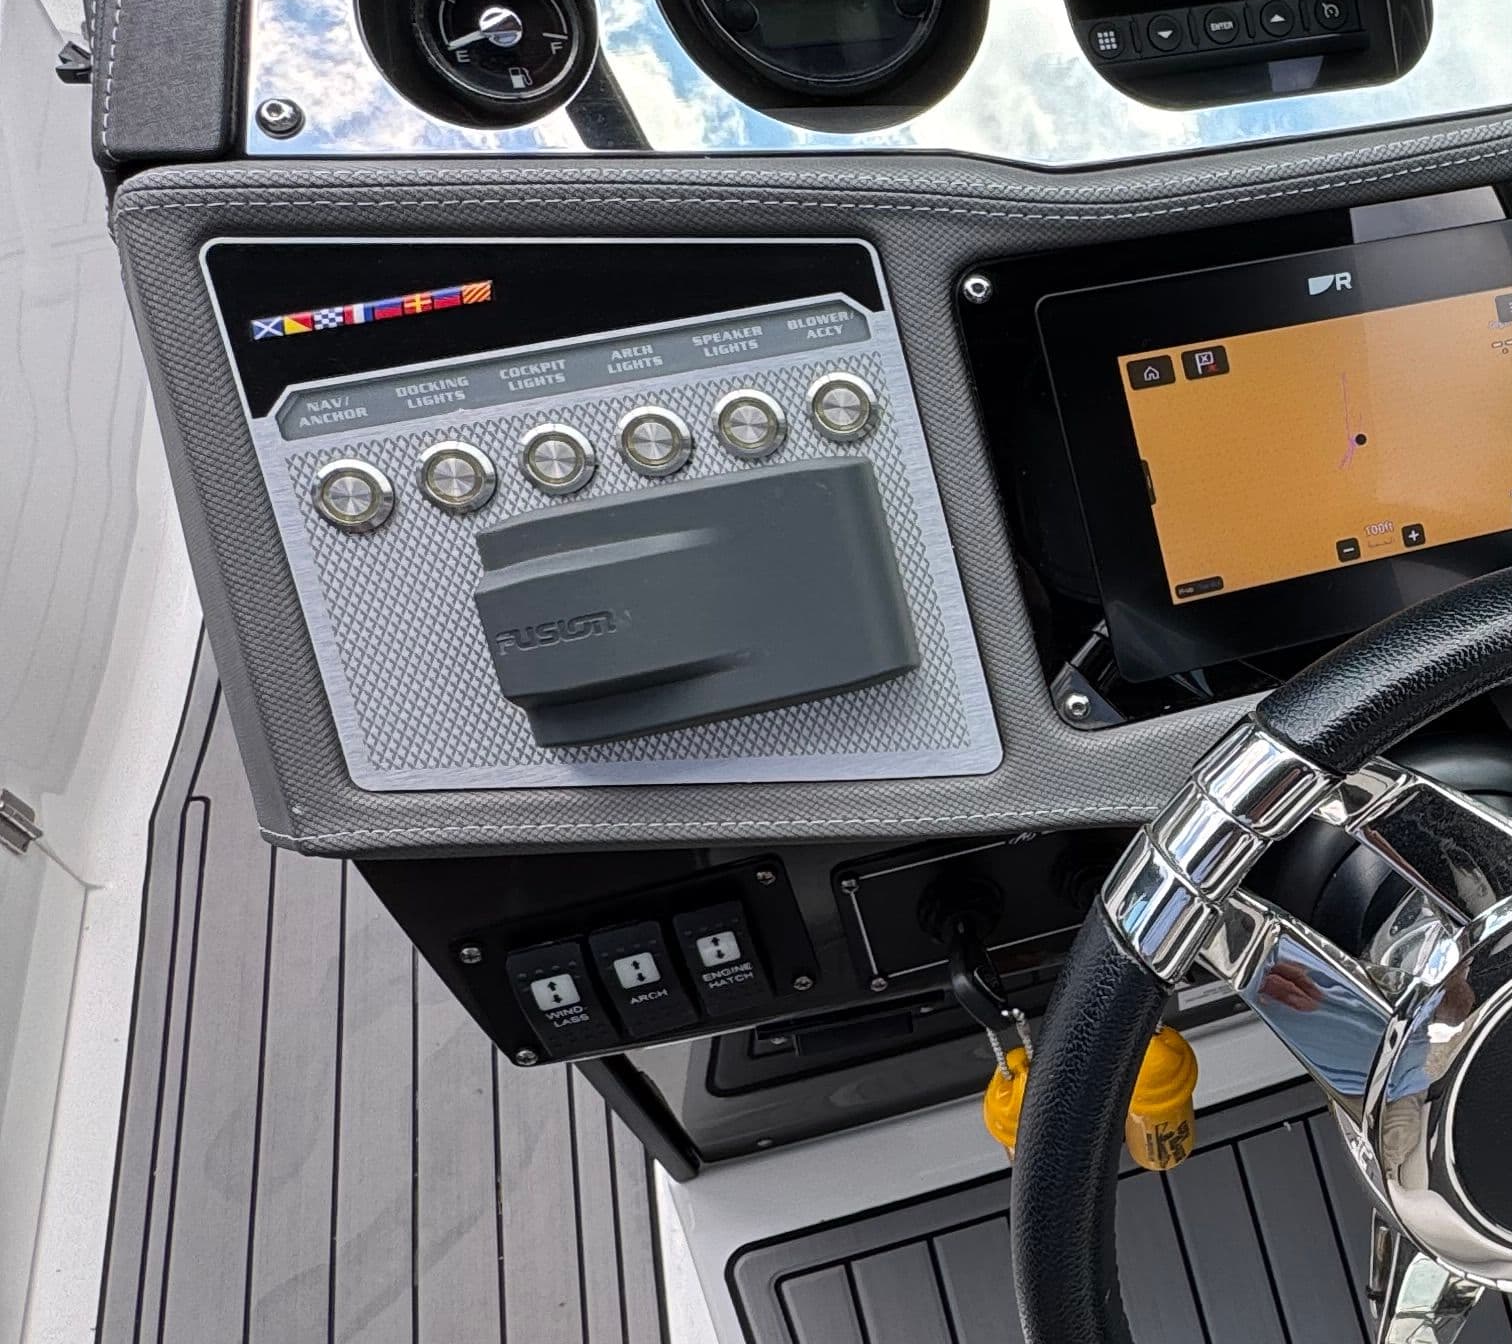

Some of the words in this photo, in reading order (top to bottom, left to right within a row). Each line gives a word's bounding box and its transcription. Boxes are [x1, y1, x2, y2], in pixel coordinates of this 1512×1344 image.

[455, 49, 471, 63] E
[550, 41, 563, 55] F
[786, 310, 855, 331] BLOWER/
[691, 324, 764, 347] SPEAKER
[806, 324, 845, 340] ACCY
[610, 343, 655, 361] ARCH
[702, 338, 760, 358] LIGHTS
[499, 358, 567, 381] COCKPIT
[606, 355, 665, 375] LIGHTS
[396, 375, 470, 399] DOCKING
[508, 372, 567, 392] LIGHTS
[306, 395, 350, 412] NAV/
[406, 389, 467, 410] LIGHTS
[298, 406, 369, 429] ANCHOR
[496, 610, 618, 655] FUSION
[701, 962, 754, 983] ENGINE
[708, 971, 754, 989] HATCH
[629, 988, 669, 1005] ARCH
[554, 1014, 591, 1028] LASS
